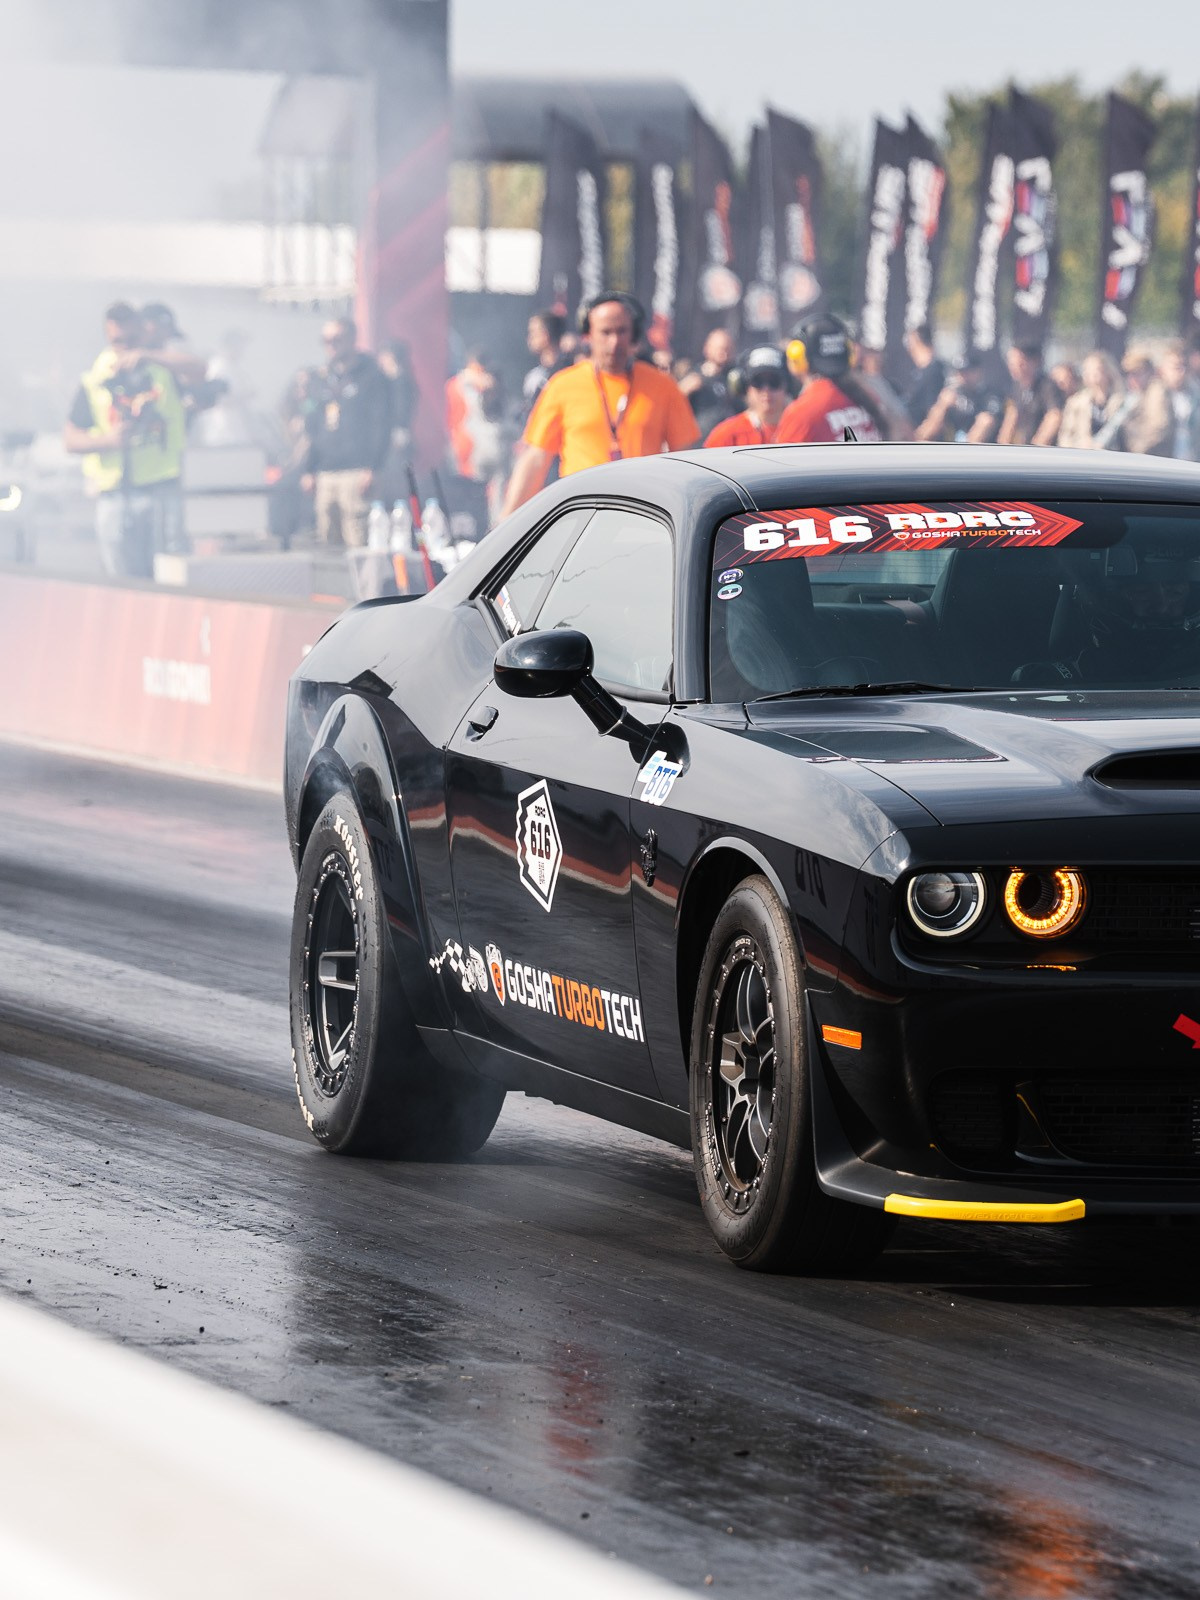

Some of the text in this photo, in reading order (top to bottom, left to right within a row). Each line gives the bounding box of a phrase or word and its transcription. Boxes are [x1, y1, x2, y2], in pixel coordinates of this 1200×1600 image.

[743, 511, 1037, 551] 616 RDRC
[912, 529, 1042, 539] GOSHATURBOTECH
[645, 766, 678, 799] ВТБ
[530, 820, 551, 860] 616
[504, 959, 645, 1043] GOSHATURBOTECH
